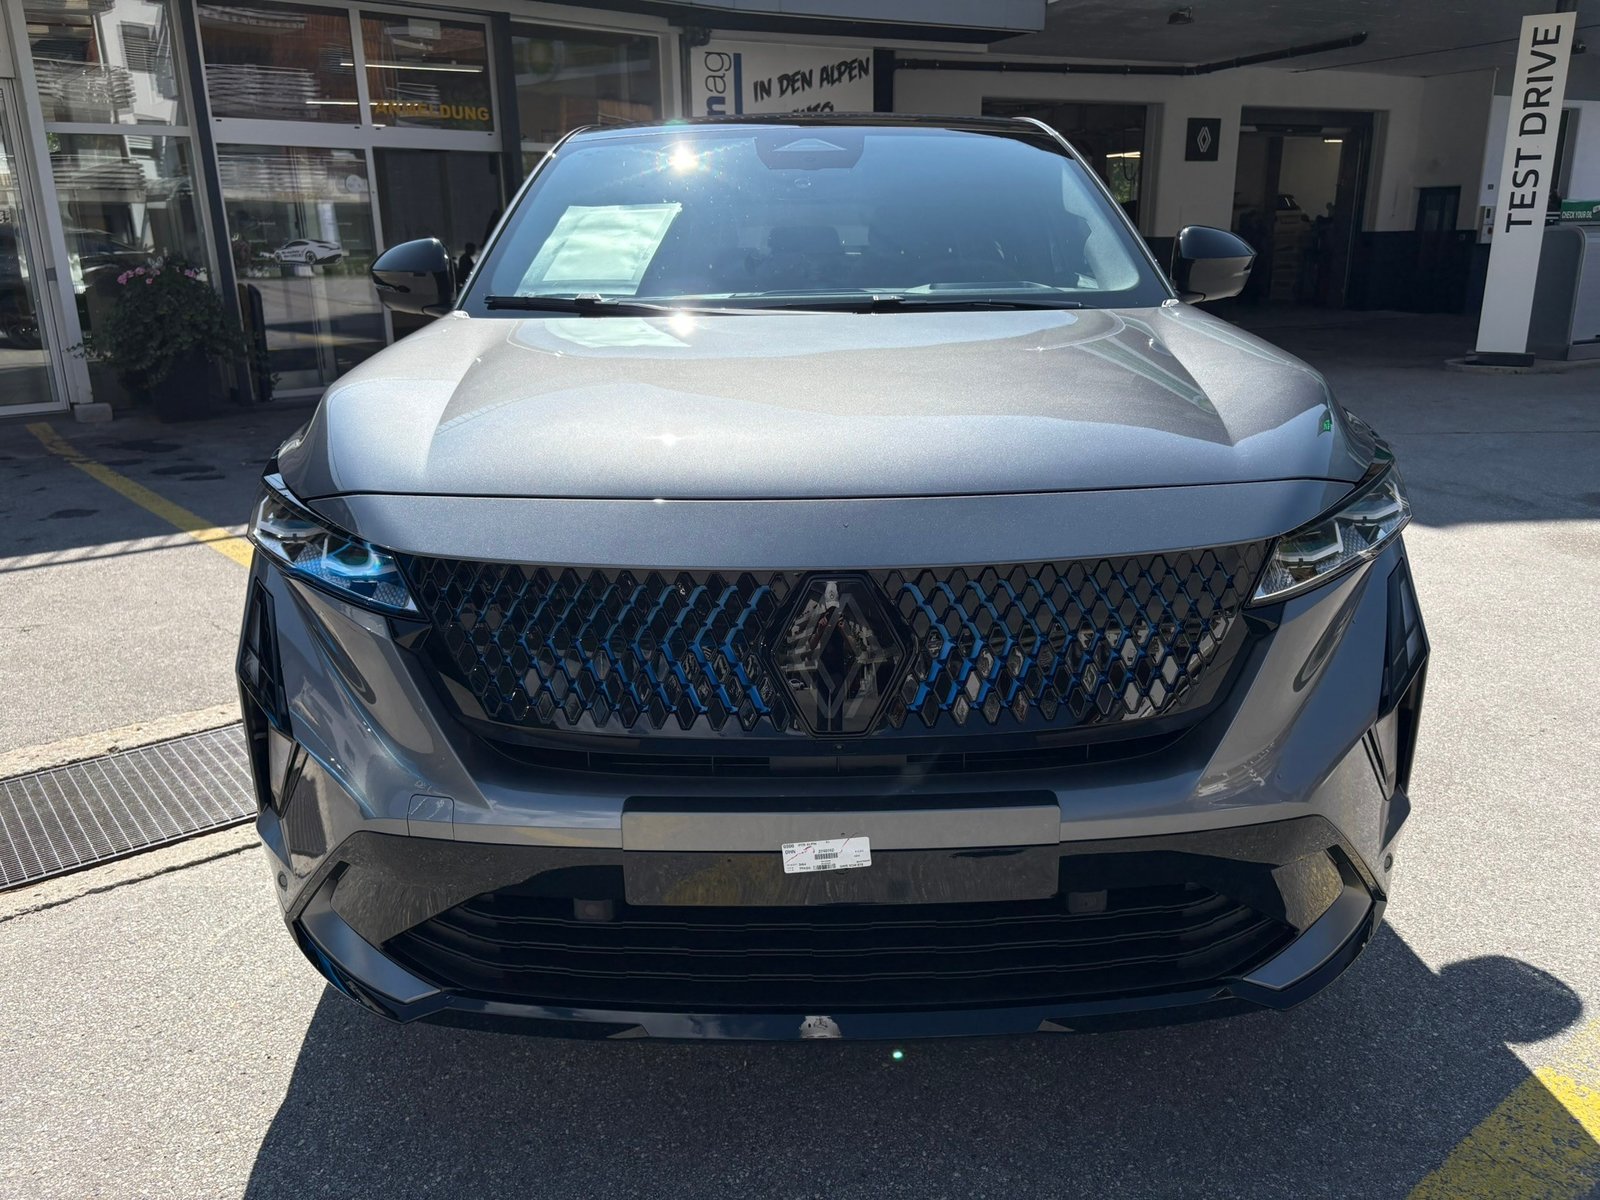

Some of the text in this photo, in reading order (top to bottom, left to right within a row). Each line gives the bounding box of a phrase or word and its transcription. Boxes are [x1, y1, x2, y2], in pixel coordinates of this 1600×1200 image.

[753, 56, 870, 103] IN DEN ALPEN
[375, 101, 490, 121] ANMELDUNG
[1505, 24, 1562, 233] TEST DRIVE
